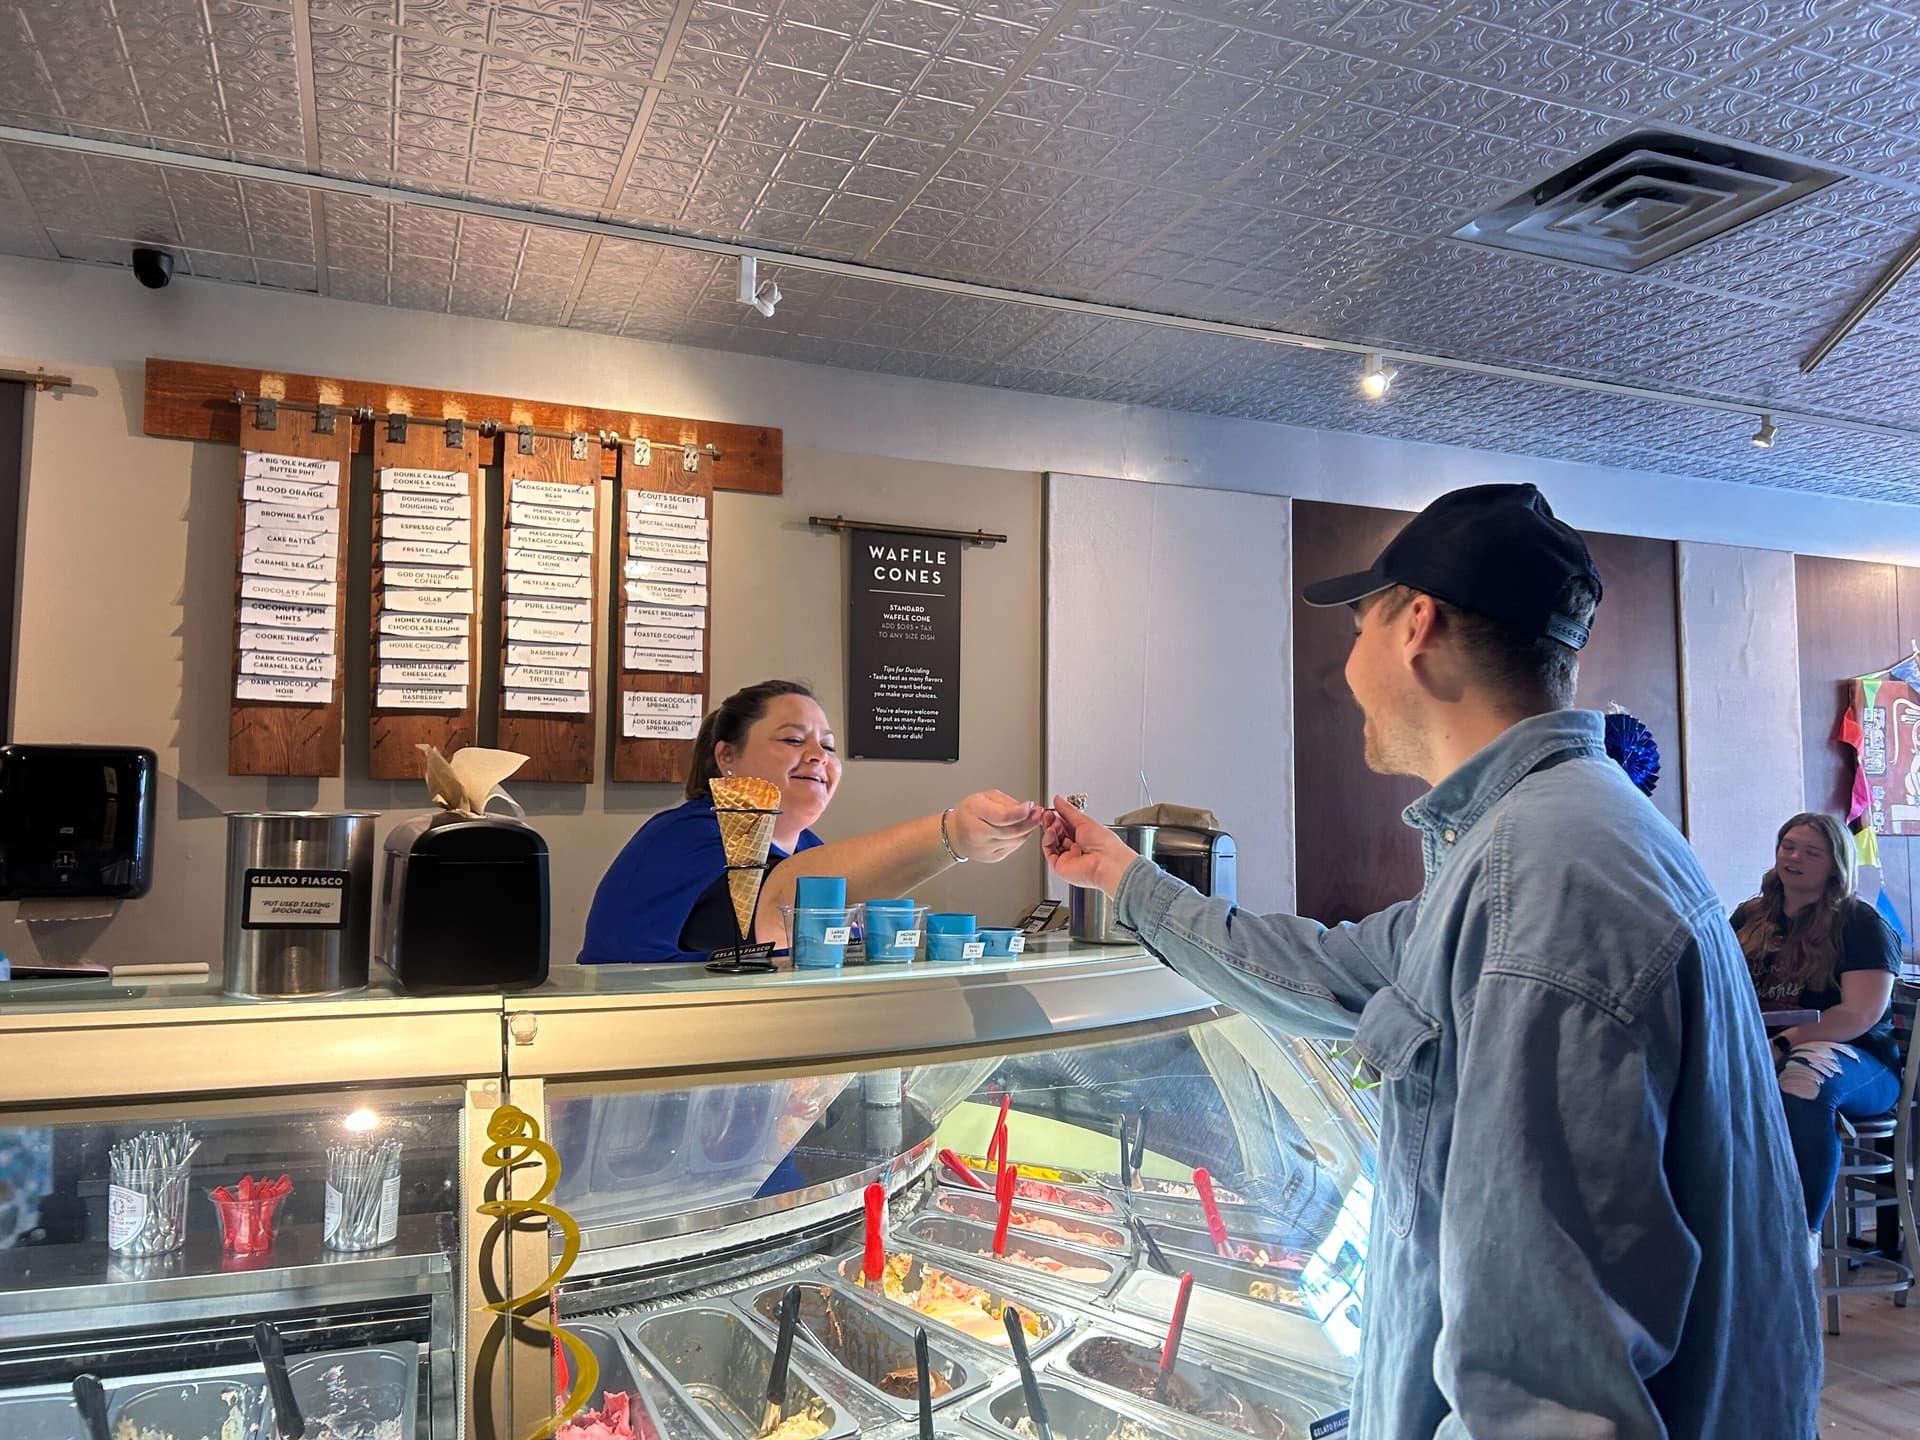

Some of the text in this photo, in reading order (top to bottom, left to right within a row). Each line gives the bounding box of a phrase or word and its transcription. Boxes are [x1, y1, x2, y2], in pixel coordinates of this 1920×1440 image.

[269, 466, 297, 474] BUTTER
[298, 461, 326, 470] PEANUT
[394, 471, 454, 481] DOUBLE CARAMEL
[256, 485, 287, 494] BLOOD
[289, 489, 324, 498] ORANGE
[516, 484, 561, 492] MADAGASCAR
[668, 495, 695, 504] SECRET
[655, 502, 678, 510] STASH
[261, 511, 295, 519] BROWNIE
[524, 514, 561, 522] BLUEBERRY
[400, 523, 434, 531] ESPRESSO
[665, 521, 696, 530] HAZELNUT
[529, 531, 573, 539] MASCARPONE
[267, 535, 316, 545] CAKE BATTER
[661, 547, 702, 555] CHEESECAKE
[869, 545, 946, 565] WAFFLE
[537, 554, 578, 562] CHOCOLATE
[254, 558, 289, 567] CARAMEL
[306, 562, 323, 570] SALT
[874, 566, 941, 584] CONES
[252, 586, 299, 595] CHOCOLATE
[302, 590, 326, 598] TAHINI
[646, 585, 687, 594] STRAWBERRY
[251, 603, 295, 612] COCONUT
[890, 604, 925, 613] STANDARD
[883, 613, 931, 623] WAFFLE CONE
[256, 633, 284, 641] COOKIE
[530, 649, 569, 657] RASPBERRY
[277, 656, 322, 664] CHOCOLATE
[253, 662, 288, 670] CARAMEL
[883, 665, 930, 675] Tips for Deciding
[522, 668, 570, 677] RASPBERRY
[529, 676, 565, 684] TRUFFLE
[873, 673, 900, 681] Taste-test
[924, 675, 943, 683] flavors
[272, 680, 318, 688] CHOCOLATE
[876, 706, 894, 714] You're
[251, 875, 344, 886] GELATO FIASCO
[714, 945, 770, 959] GELA FIASCO
